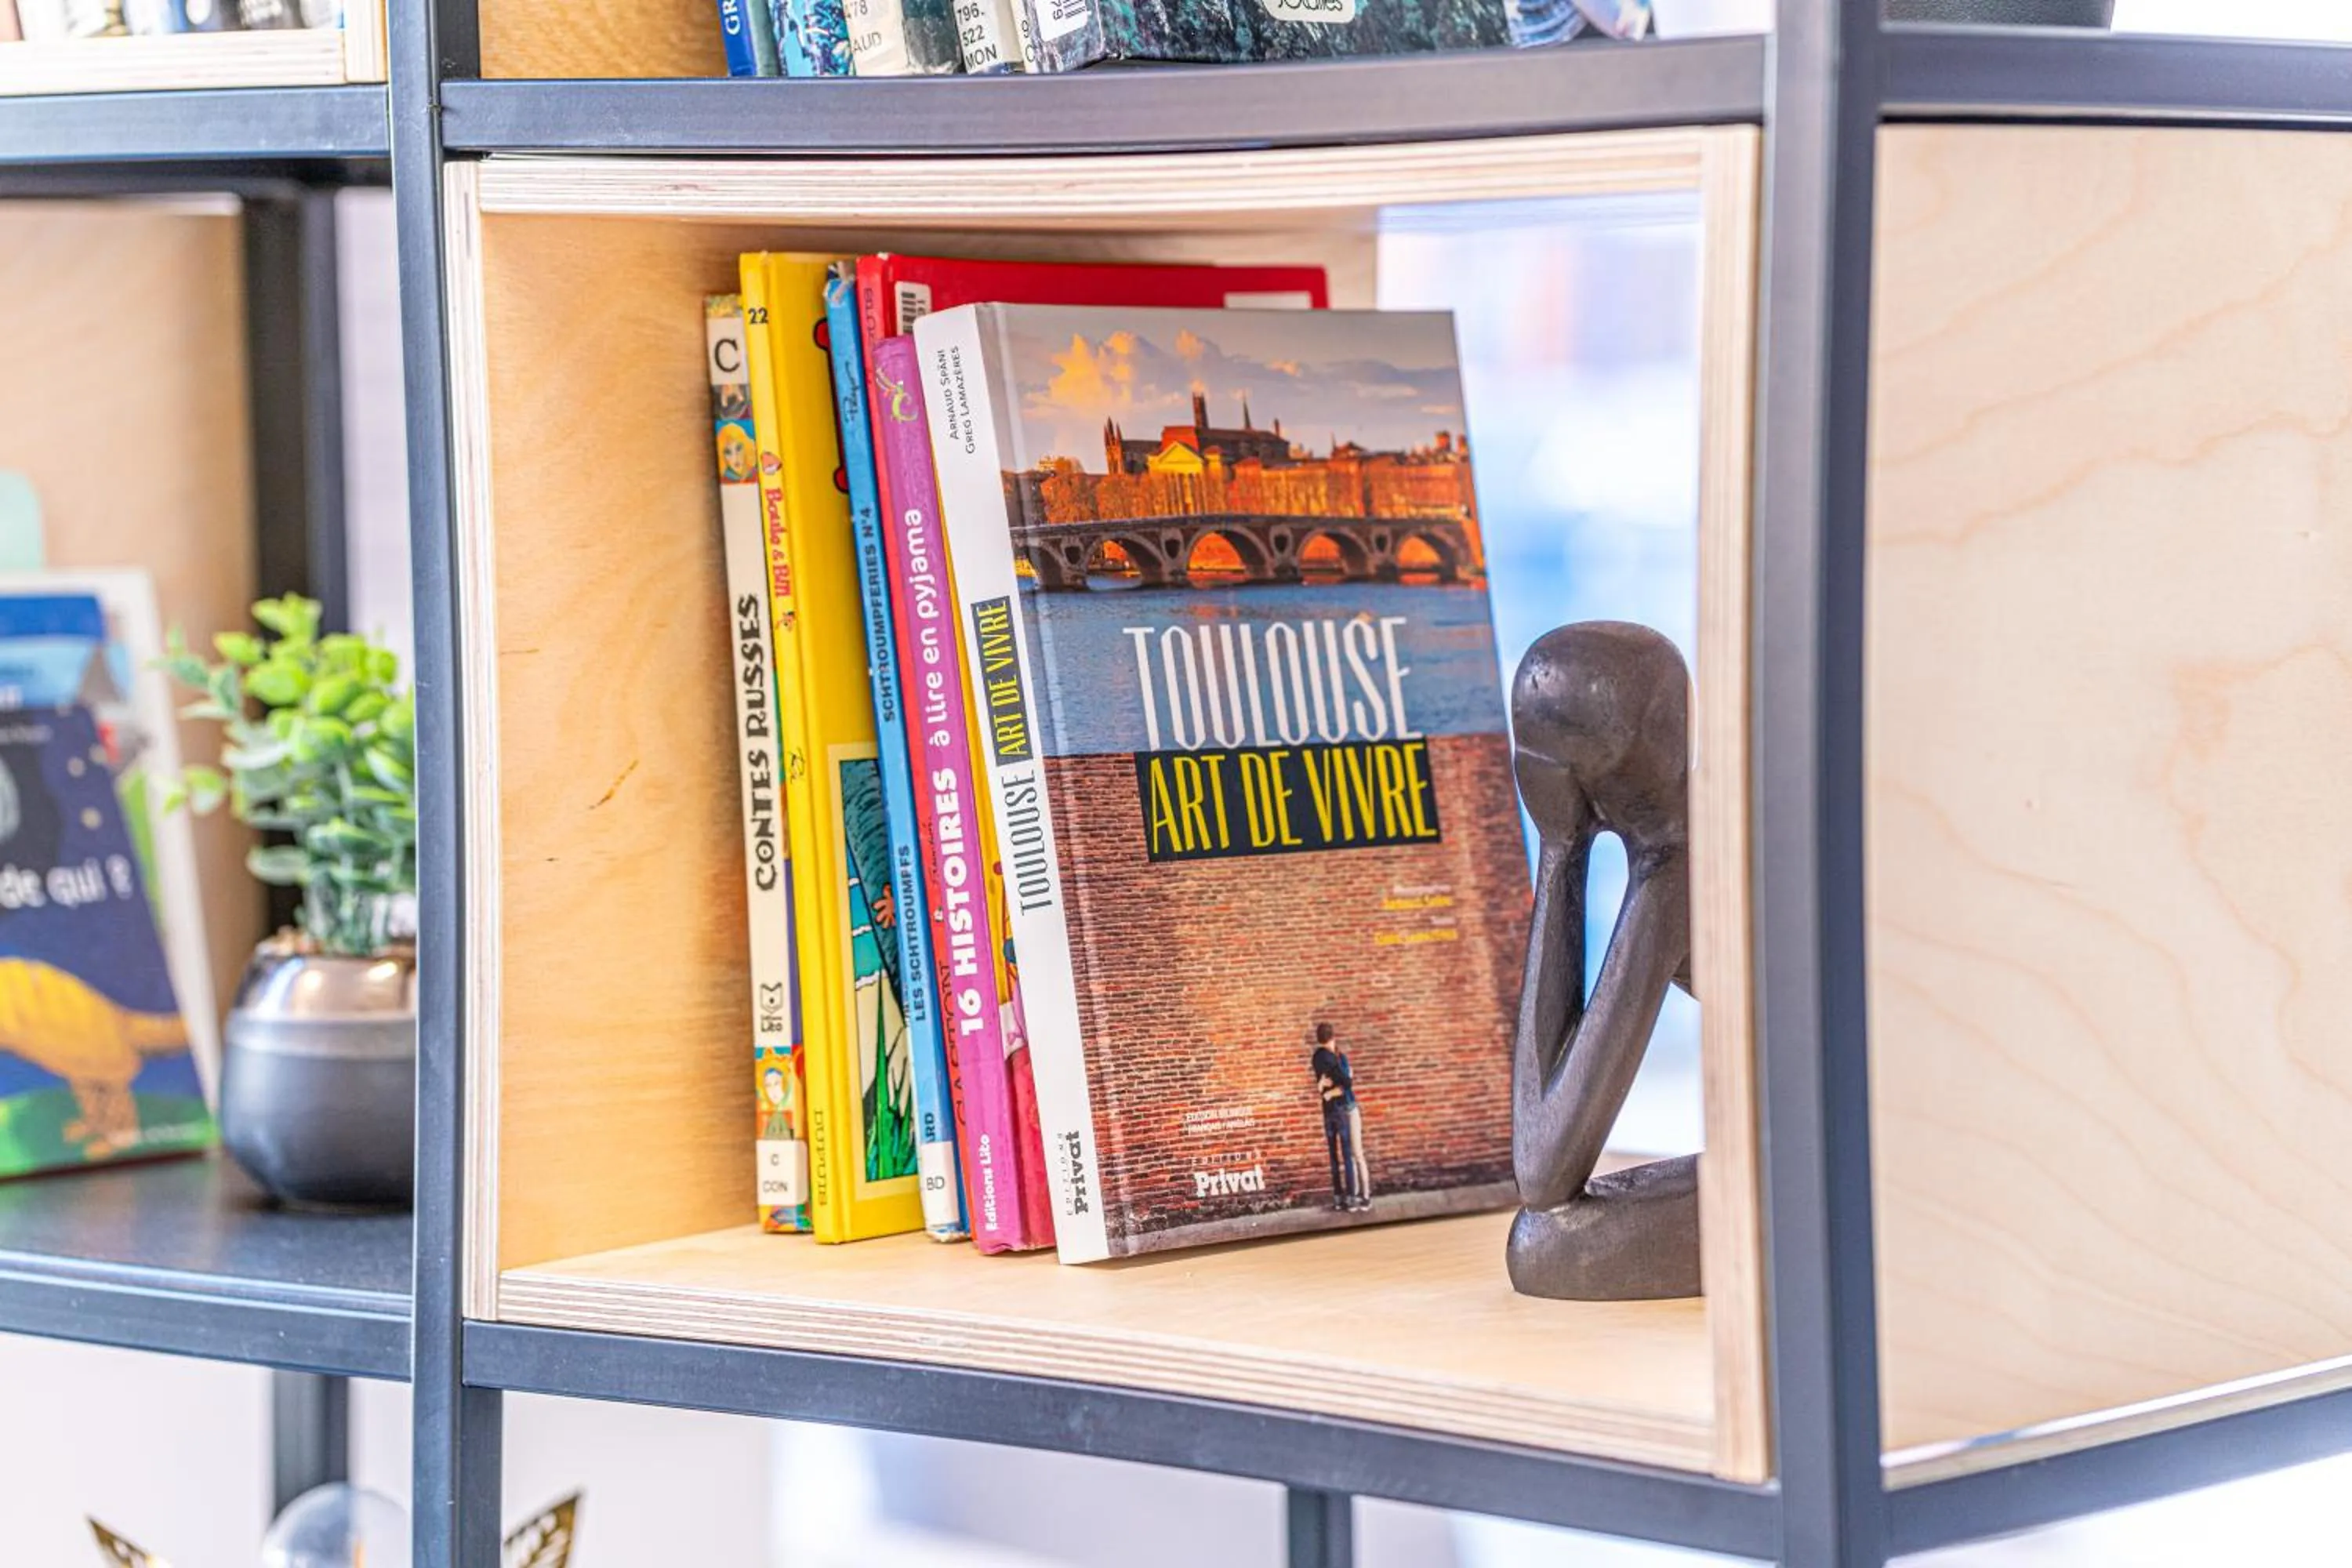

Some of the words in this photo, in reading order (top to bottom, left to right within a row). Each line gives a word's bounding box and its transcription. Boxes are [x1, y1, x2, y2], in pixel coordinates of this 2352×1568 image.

[956, 2, 985, 25] 796.
[962, 24, 985, 47] 522
[965, 44, 998, 70] MON
[748, 308, 768, 324] 22
[714, 338, 740, 372] C
[943, 390, 960, 440] ARNAUD
[963, 419, 975, 454] GREG
[773, 564, 791, 597] Bill
[904, 508, 938, 619] pyjama
[860, 543, 896, 723] SCHTROUMPFERIES
[917, 627, 939, 664] en
[978, 599, 1014, 673] VIVRE
[738, 594, 769, 738] RUSSES
[1123, 616, 1423, 752] TOULOUSE
[924, 671, 949, 724] lire
[988, 673, 1021, 712] DE
[996, 713, 1025, 757] ART
[749, 749, 778, 891] CONTES
[1149, 754, 1230, 854] ART
[1240, 750, 1302, 848] DE
[1302, 742, 1438, 843] VIVRE
[1002, 768, 1052, 916] TOULOUSE
[933, 768, 978, 976] HISTOIRES
[898, 844, 923, 982] SCHTROUMPFS
[913, 987, 926, 1022] LES
[957, 988, 984, 1036] 16
[980, 1134, 992, 1164] Lito
[1065, 1131, 1089, 1215] Privat
[927, 1176, 946, 1190] BD
[985, 1168, 998, 1231] Editions
[1194, 1164, 1266, 1197] Privat
